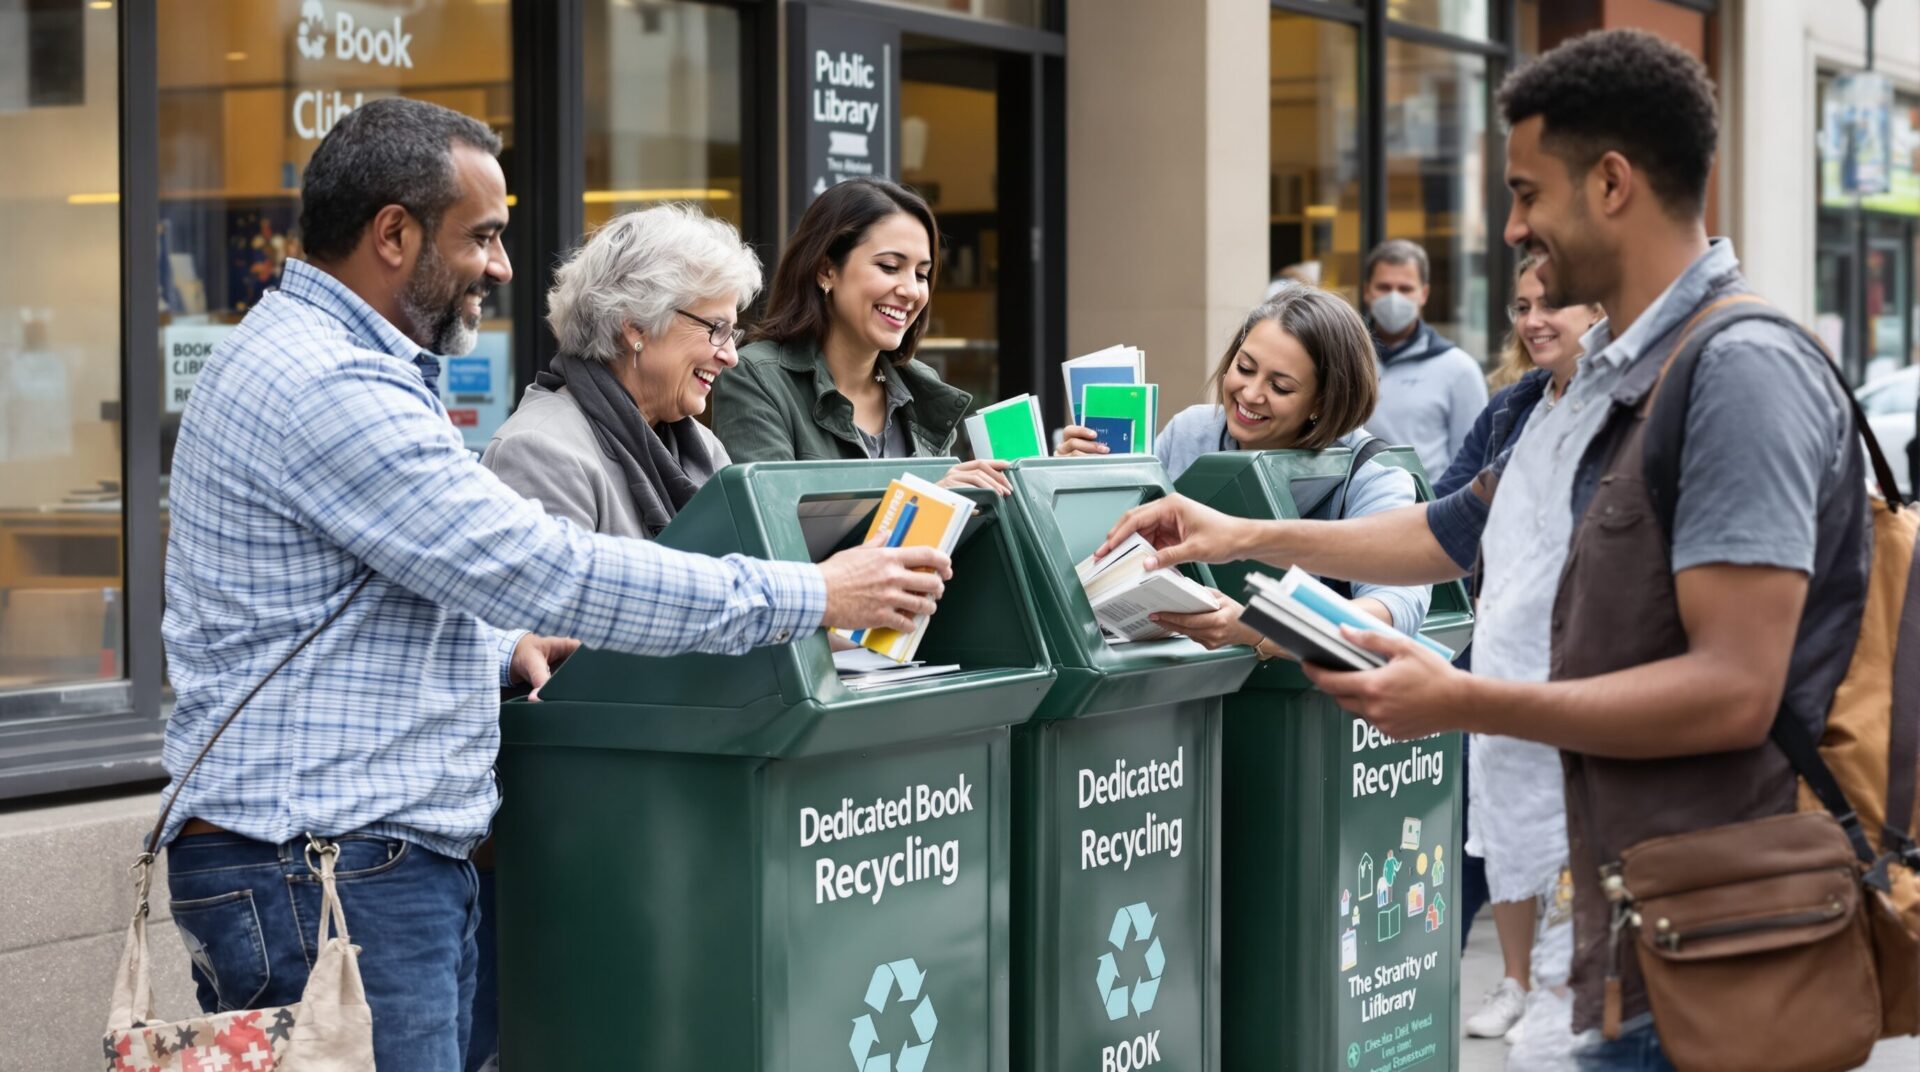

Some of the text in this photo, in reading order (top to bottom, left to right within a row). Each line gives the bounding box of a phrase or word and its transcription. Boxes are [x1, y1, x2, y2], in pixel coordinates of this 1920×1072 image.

[336, 11, 413, 69] Book
[815, 50, 875, 89] Public
[813, 89, 879, 133] Library
[1079, 746, 1183, 808] Dedicated
[1352, 746, 1443, 798] Recycling
[800, 773, 974, 847] Dedicated Book
[1081, 812, 1182, 871] Recycling
[815, 835, 959, 905] Recycling
[1348, 974, 1372, 998] The
[1423, 951, 1438, 970] or
[1102, 1029, 1161, 1072] BOOK
